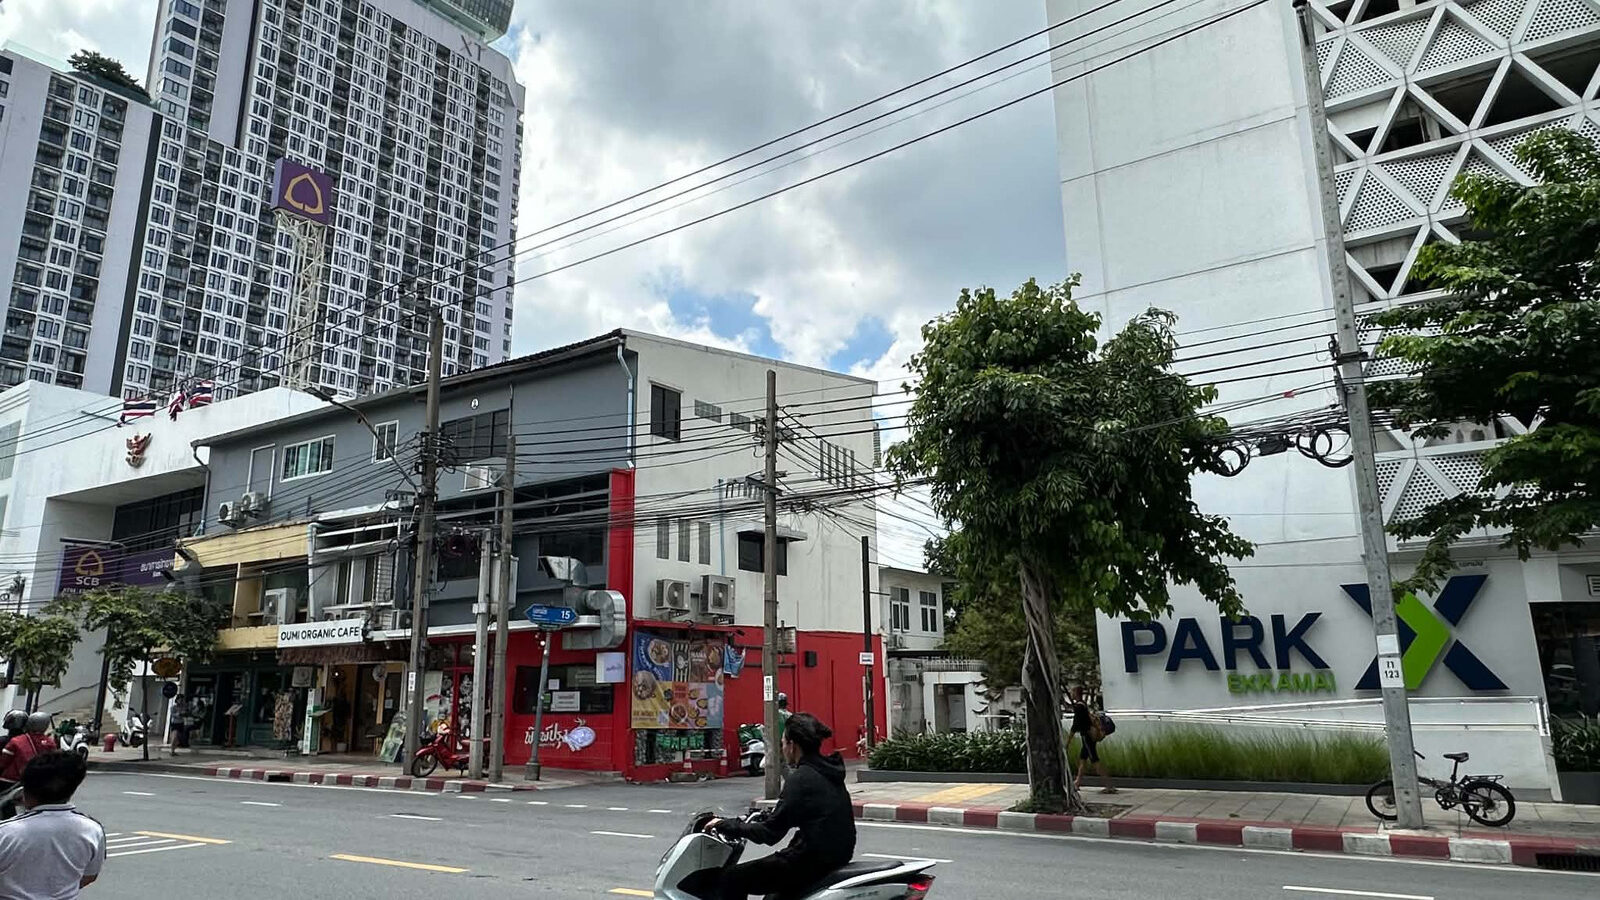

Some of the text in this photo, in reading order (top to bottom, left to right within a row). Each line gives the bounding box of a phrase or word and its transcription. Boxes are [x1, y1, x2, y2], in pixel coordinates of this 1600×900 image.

[75, 576, 100, 586] SCB
[561, 610, 570, 619] 15
[280, 626, 359, 641] OUMI ORGANIC CAFE
[1120, 612, 1331, 673] PARK
[1384, 670, 1400, 679] 123
[1227, 673, 1337, 694] EKKAMAI
